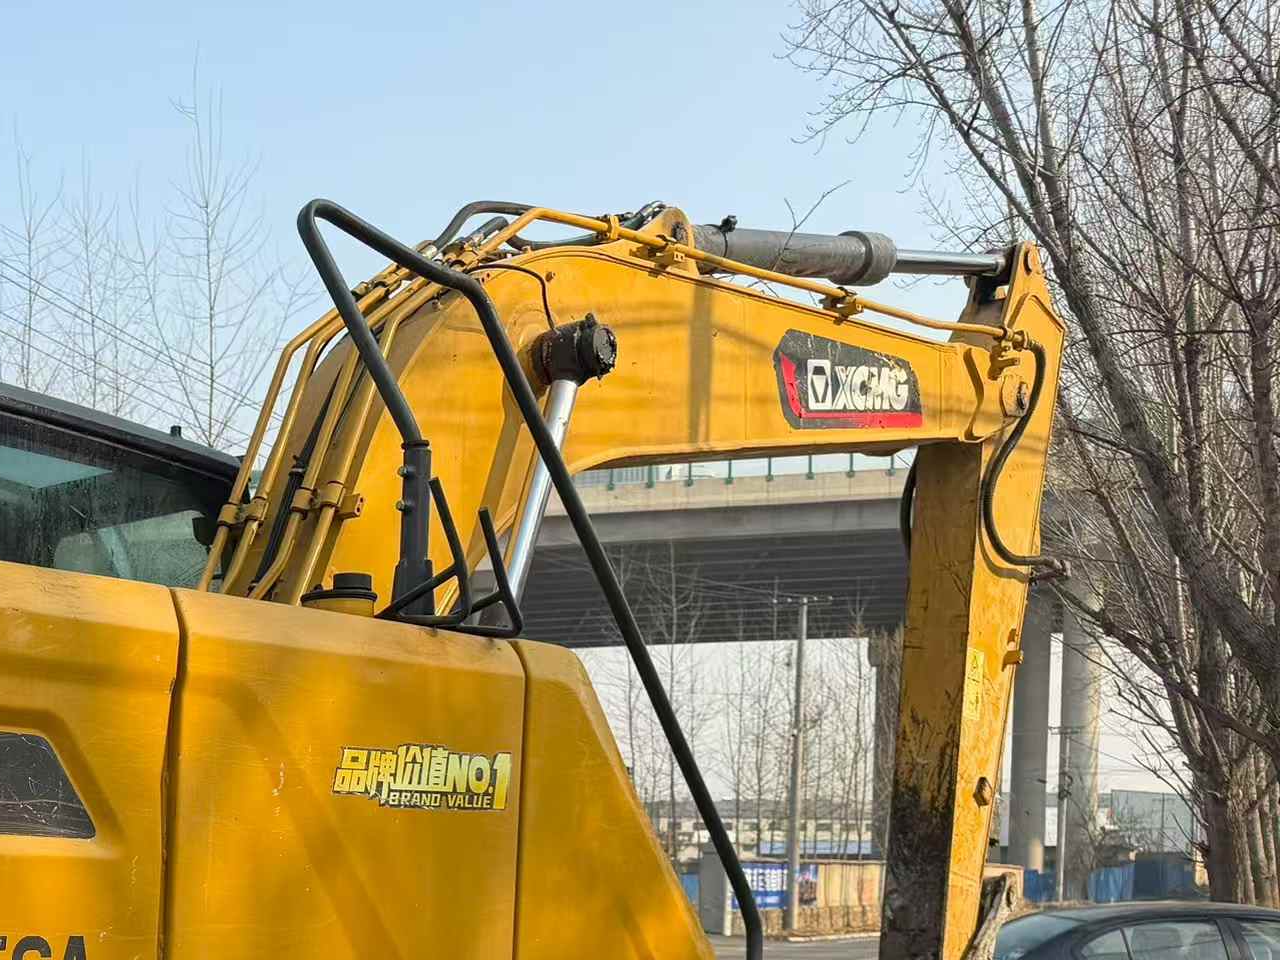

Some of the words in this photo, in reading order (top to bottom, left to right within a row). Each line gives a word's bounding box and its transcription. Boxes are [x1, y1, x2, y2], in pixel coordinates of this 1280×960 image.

[832, 365, 909, 411] XCMG
[389, 790, 441, 807] BRAND
[447, 793, 492, 808] VALUE
